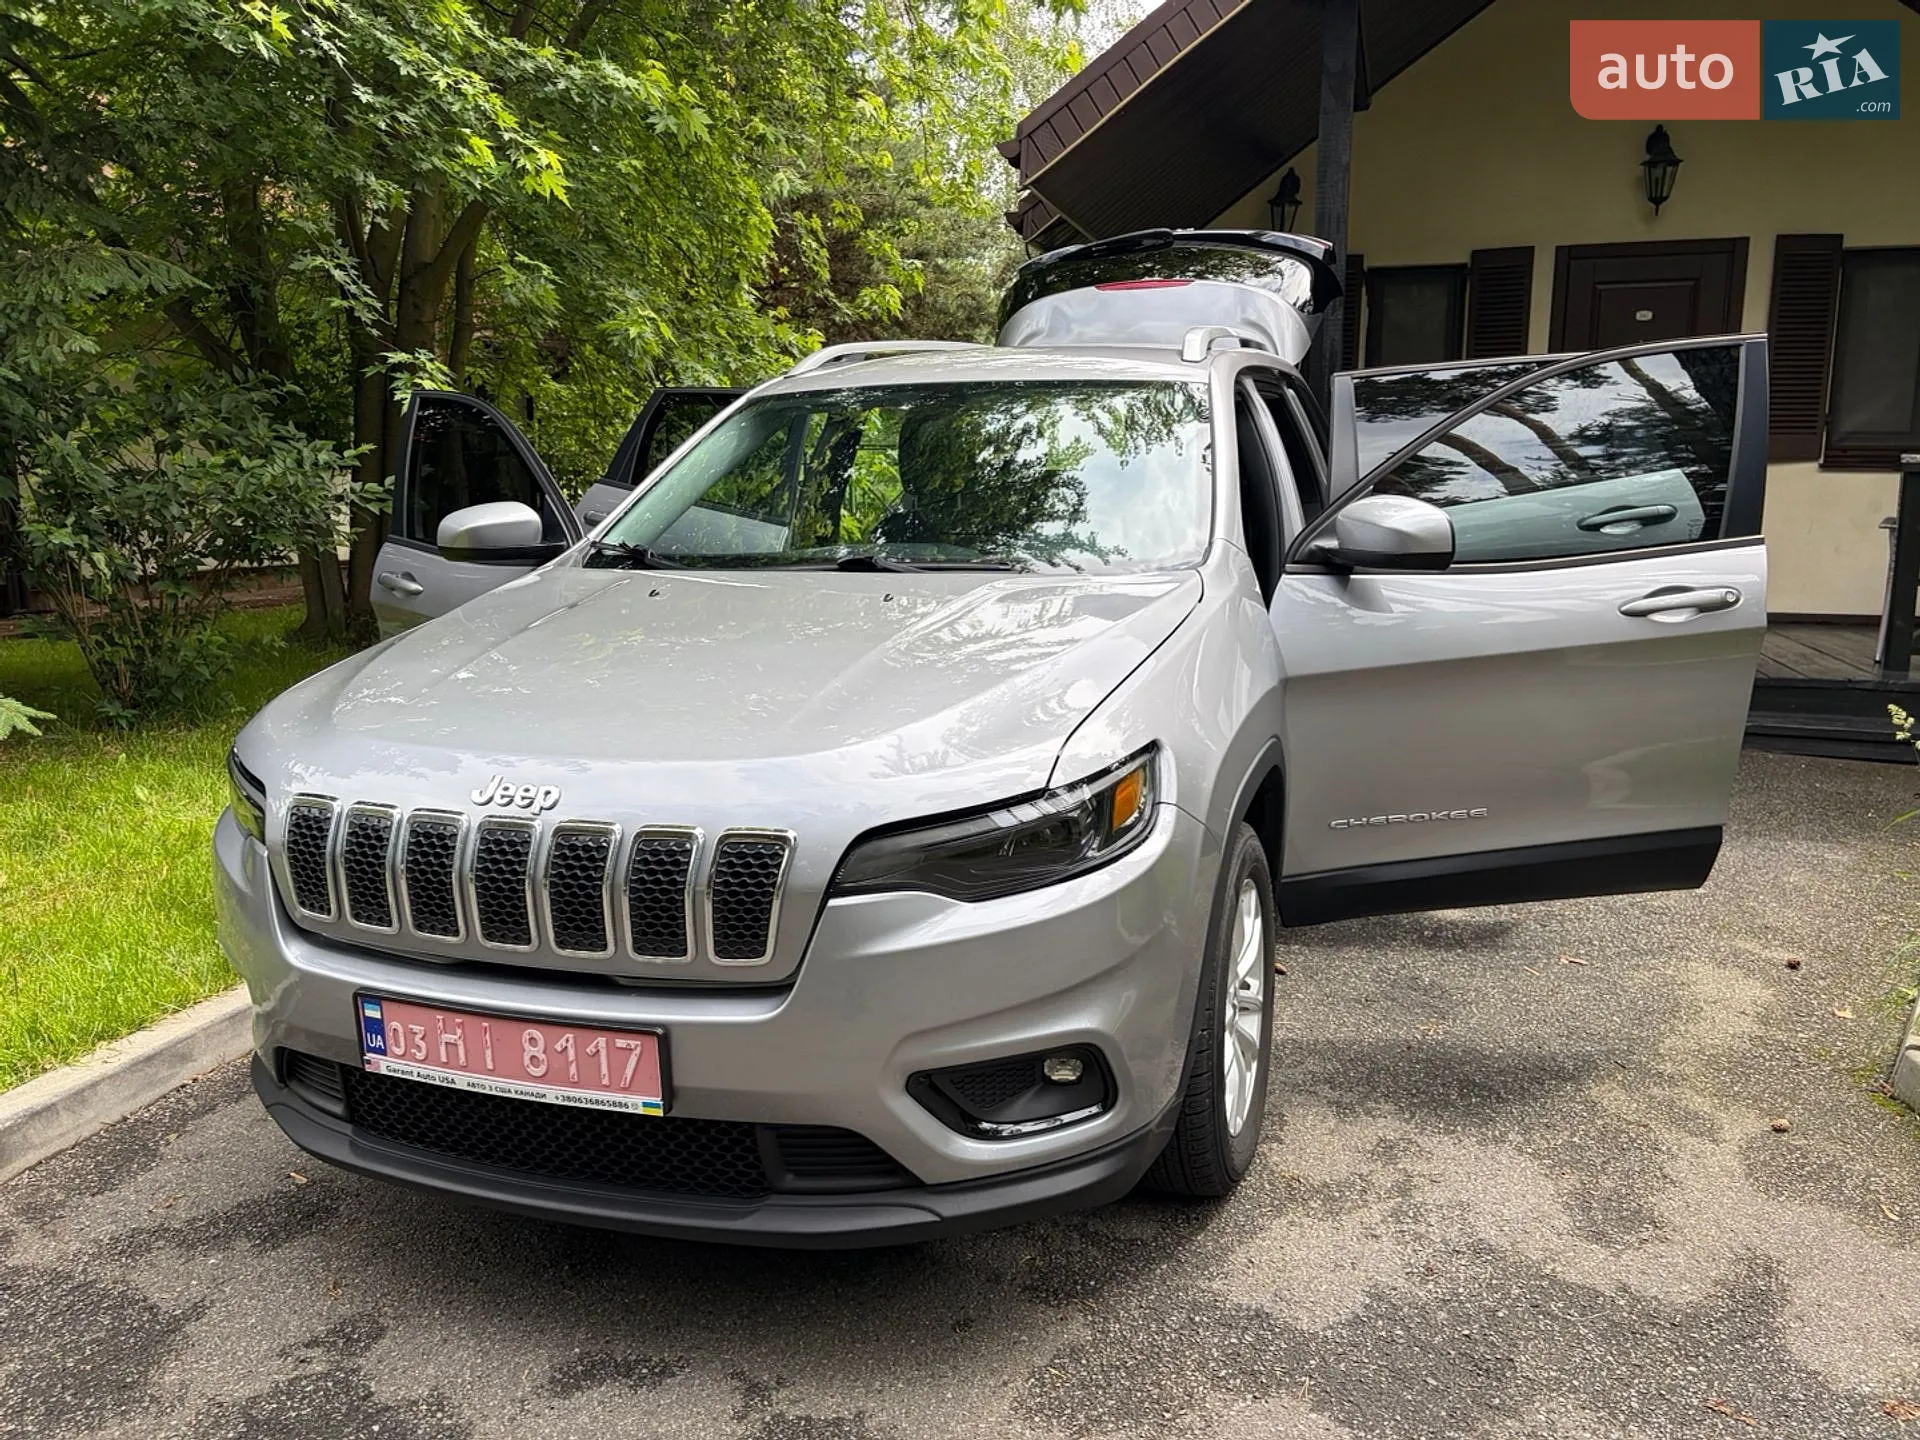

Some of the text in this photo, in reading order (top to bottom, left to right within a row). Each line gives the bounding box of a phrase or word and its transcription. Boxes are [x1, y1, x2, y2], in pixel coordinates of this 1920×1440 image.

[470, 774, 562, 816] Jeep
[1329, 807, 1489, 829] CHEROKEE
[367, 1035, 385, 1050] UA
[521, 1029, 642, 1088] 8117
[386, 1065, 456, 1085] Garant Auto USA
